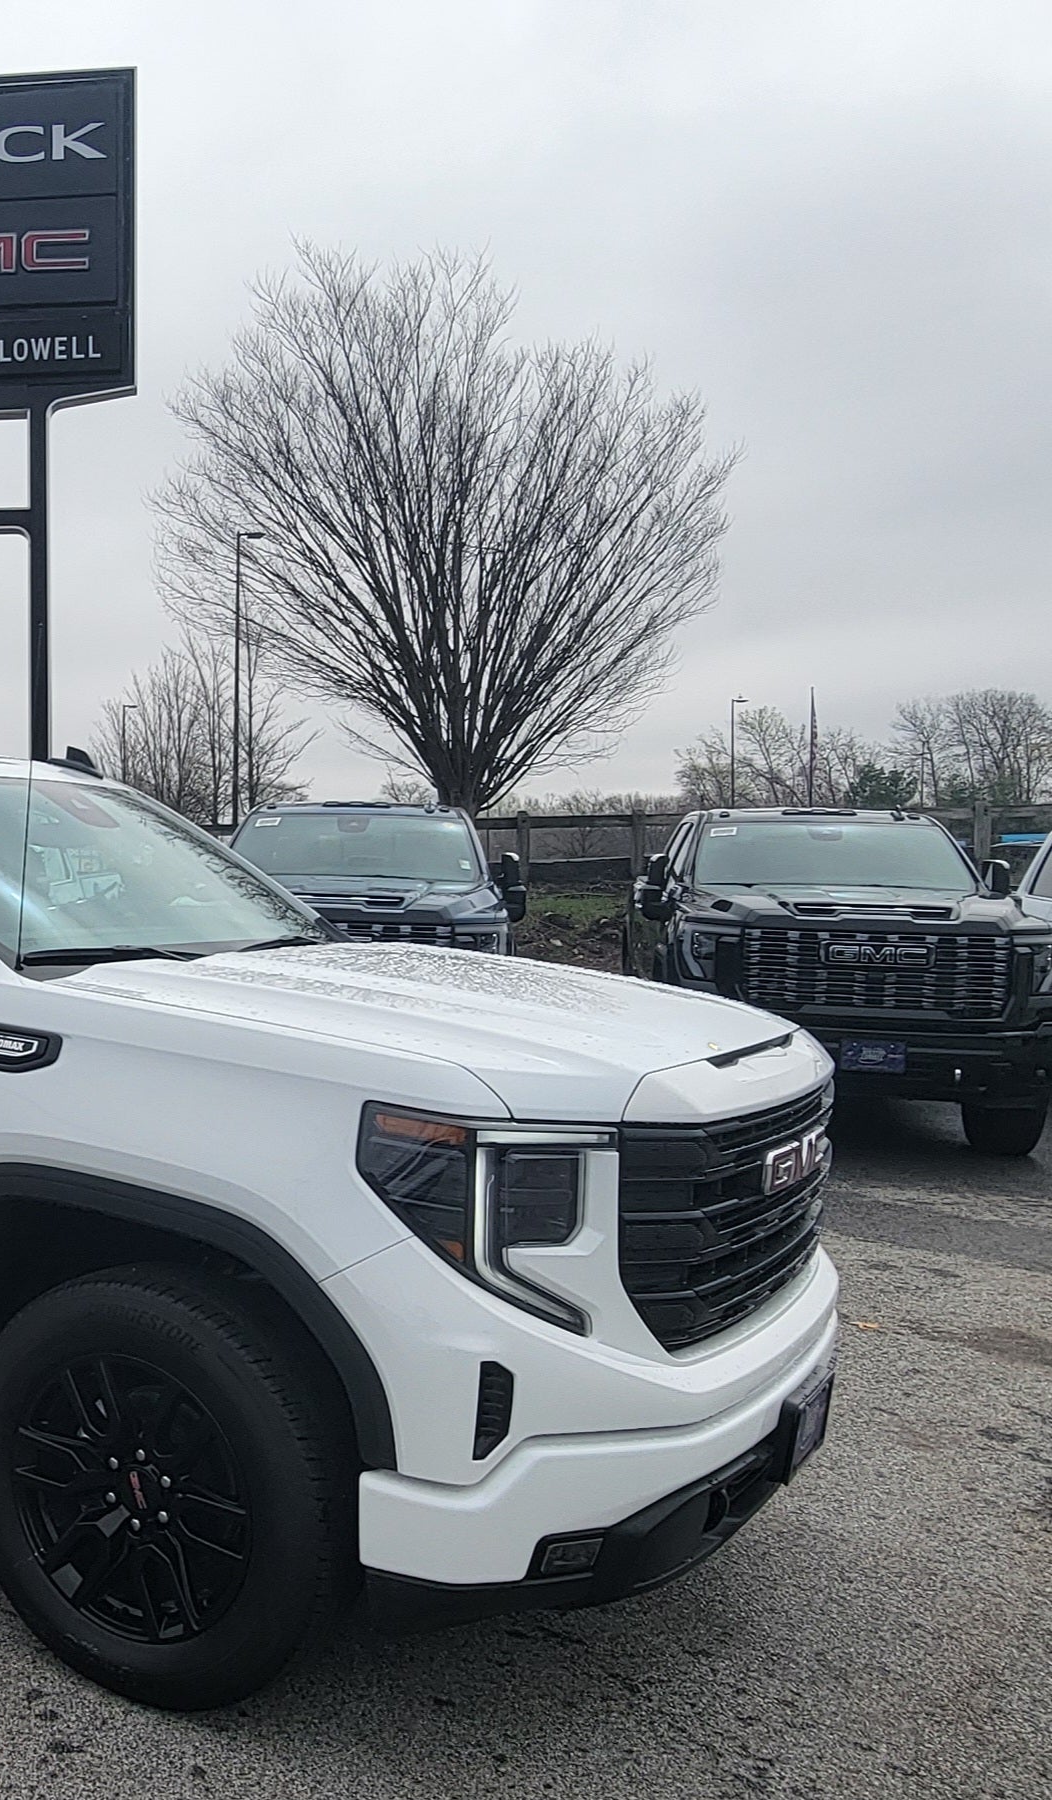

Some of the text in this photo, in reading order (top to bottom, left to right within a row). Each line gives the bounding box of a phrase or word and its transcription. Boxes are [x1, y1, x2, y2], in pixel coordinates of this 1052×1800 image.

[828, 945, 928, 965] GMC
[762, 1125, 825, 1196] GMC
[129, 1471, 148, 1510] GMC
